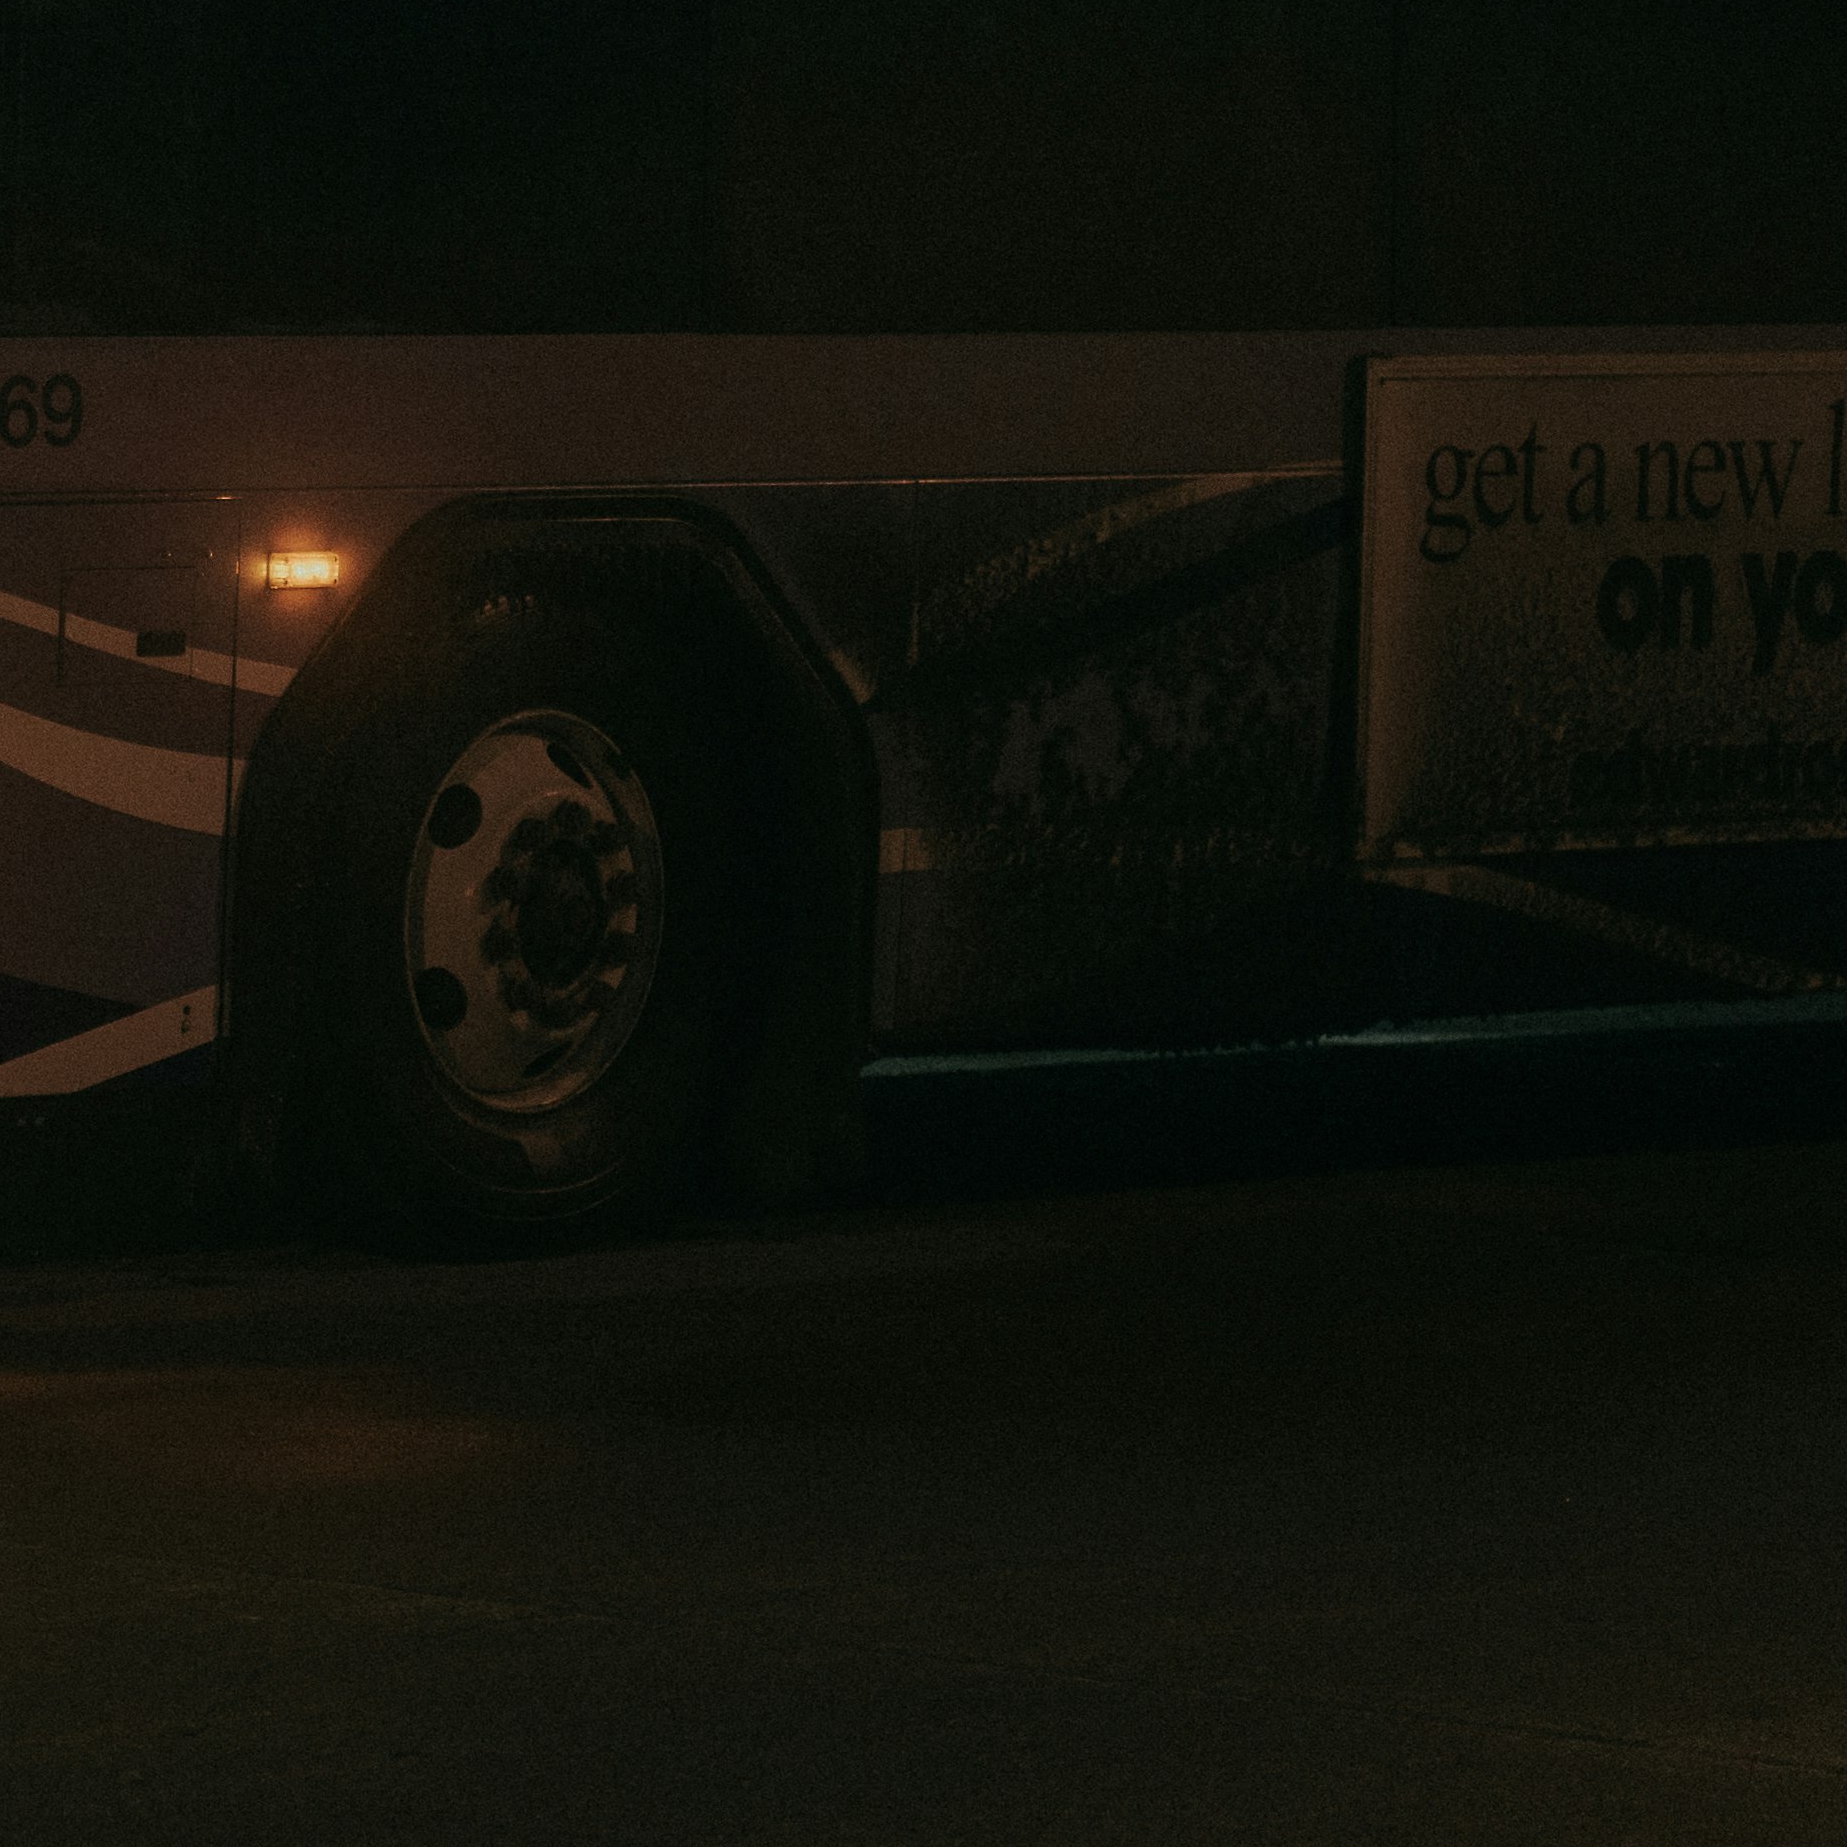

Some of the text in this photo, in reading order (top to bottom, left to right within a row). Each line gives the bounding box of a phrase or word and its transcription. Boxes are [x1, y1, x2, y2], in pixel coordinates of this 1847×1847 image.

[1419, 422, 1544, 563] get
[1566, 444, 1612, 527] a
[1634, 437, 1803, 523] new
[1597, 555, 1716, 653] on
